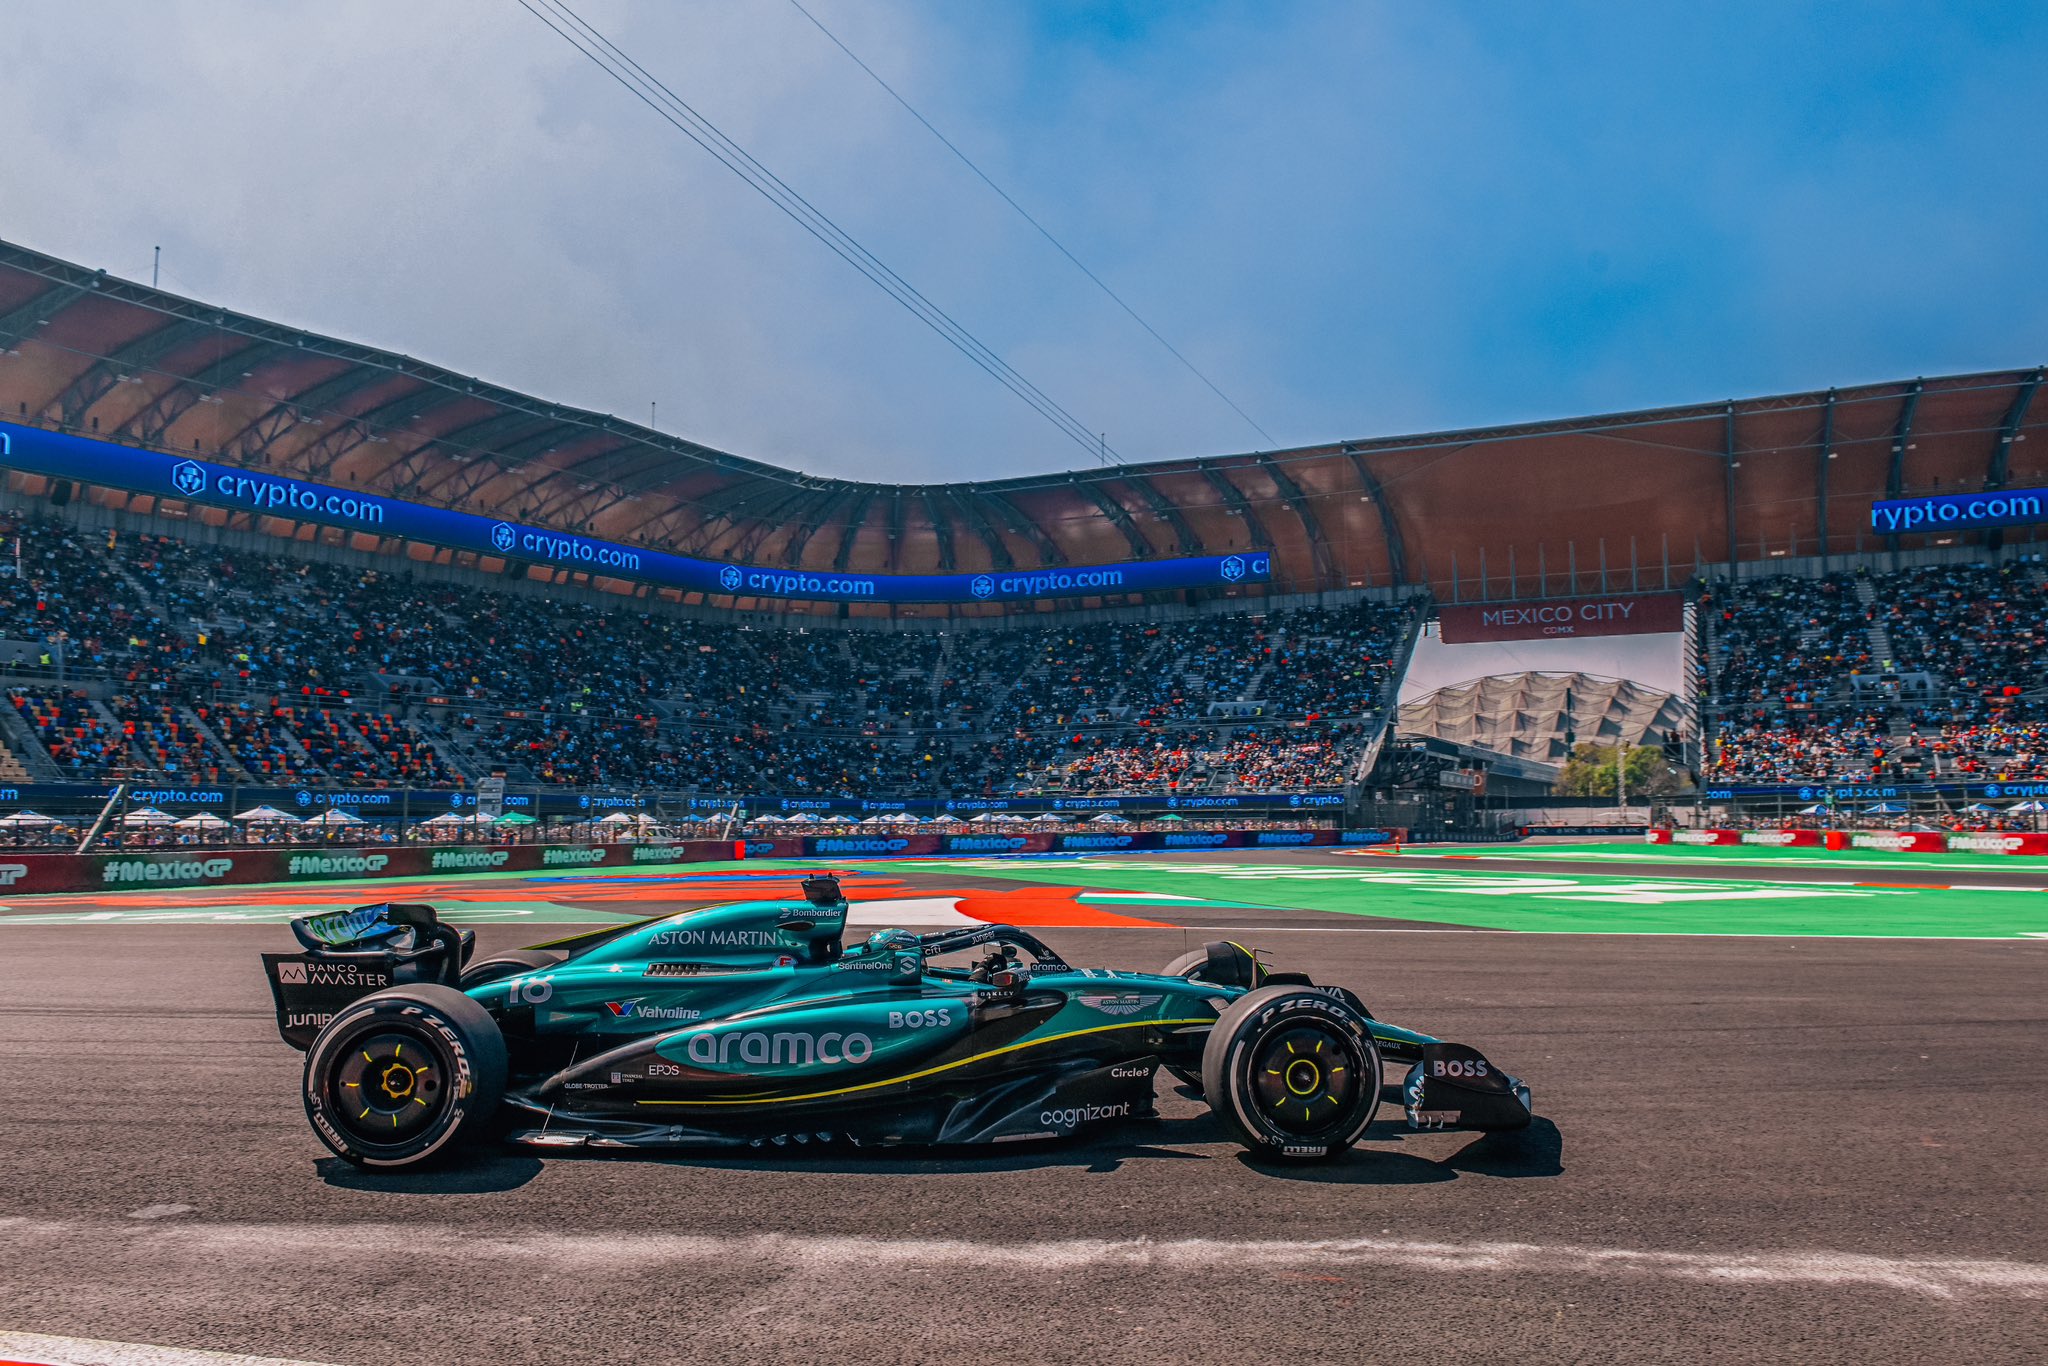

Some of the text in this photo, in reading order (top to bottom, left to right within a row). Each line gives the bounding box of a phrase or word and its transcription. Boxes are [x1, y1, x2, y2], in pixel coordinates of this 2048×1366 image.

[216, 474, 383, 523] crypto.com
[522, 531, 640, 571] crypto.com
[748, 574, 875, 595] crypto.com
[1000, 567, 1123, 595] crypto.com
[1483, 602, 1634, 626] MEXICO CITY
[132, 788, 224, 804] crypto.com
[816, 839, 909, 852] #MexicoGP
[950, 837, 1028, 850] #MexicoGP
[1063, 835, 1133, 848] #MexicoGP
[431, 851, 509, 869] #MexicoGP
[543, 848, 606, 864] #MexicoGP
[633, 845, 685, 861] #MexicoGP
[102, 858, 233, 883] #MexicoGP
[288, 854, 389, 875] #MexicoGP
[792, 908, 842, 917] Bombardier
[648, 930, 777, 946] ASTON MARTIN
[924, 944, 942, 956] citi
[308, 964, 358, 973] BANCO
[838, 961, 893, 971] SentinelOne
[1031, 963, 1068, 972] aramco
[311, 973, 388, 986] MASTER
[636, 1006, 702, 1020] Valvoline
[889, 1008, 951, 1029] BOSS
[1262, 999, 1347, 1025] P ZERO
[400, 1006, 471, 1076] P ZERO
[688, 1032, 873, 1065] aramco
[648, 1064, 680, 1076] EPOS
[1433, 1060, 1488, 1077] BOSS
[1040, 1101, 1130, 1128] cognizant
